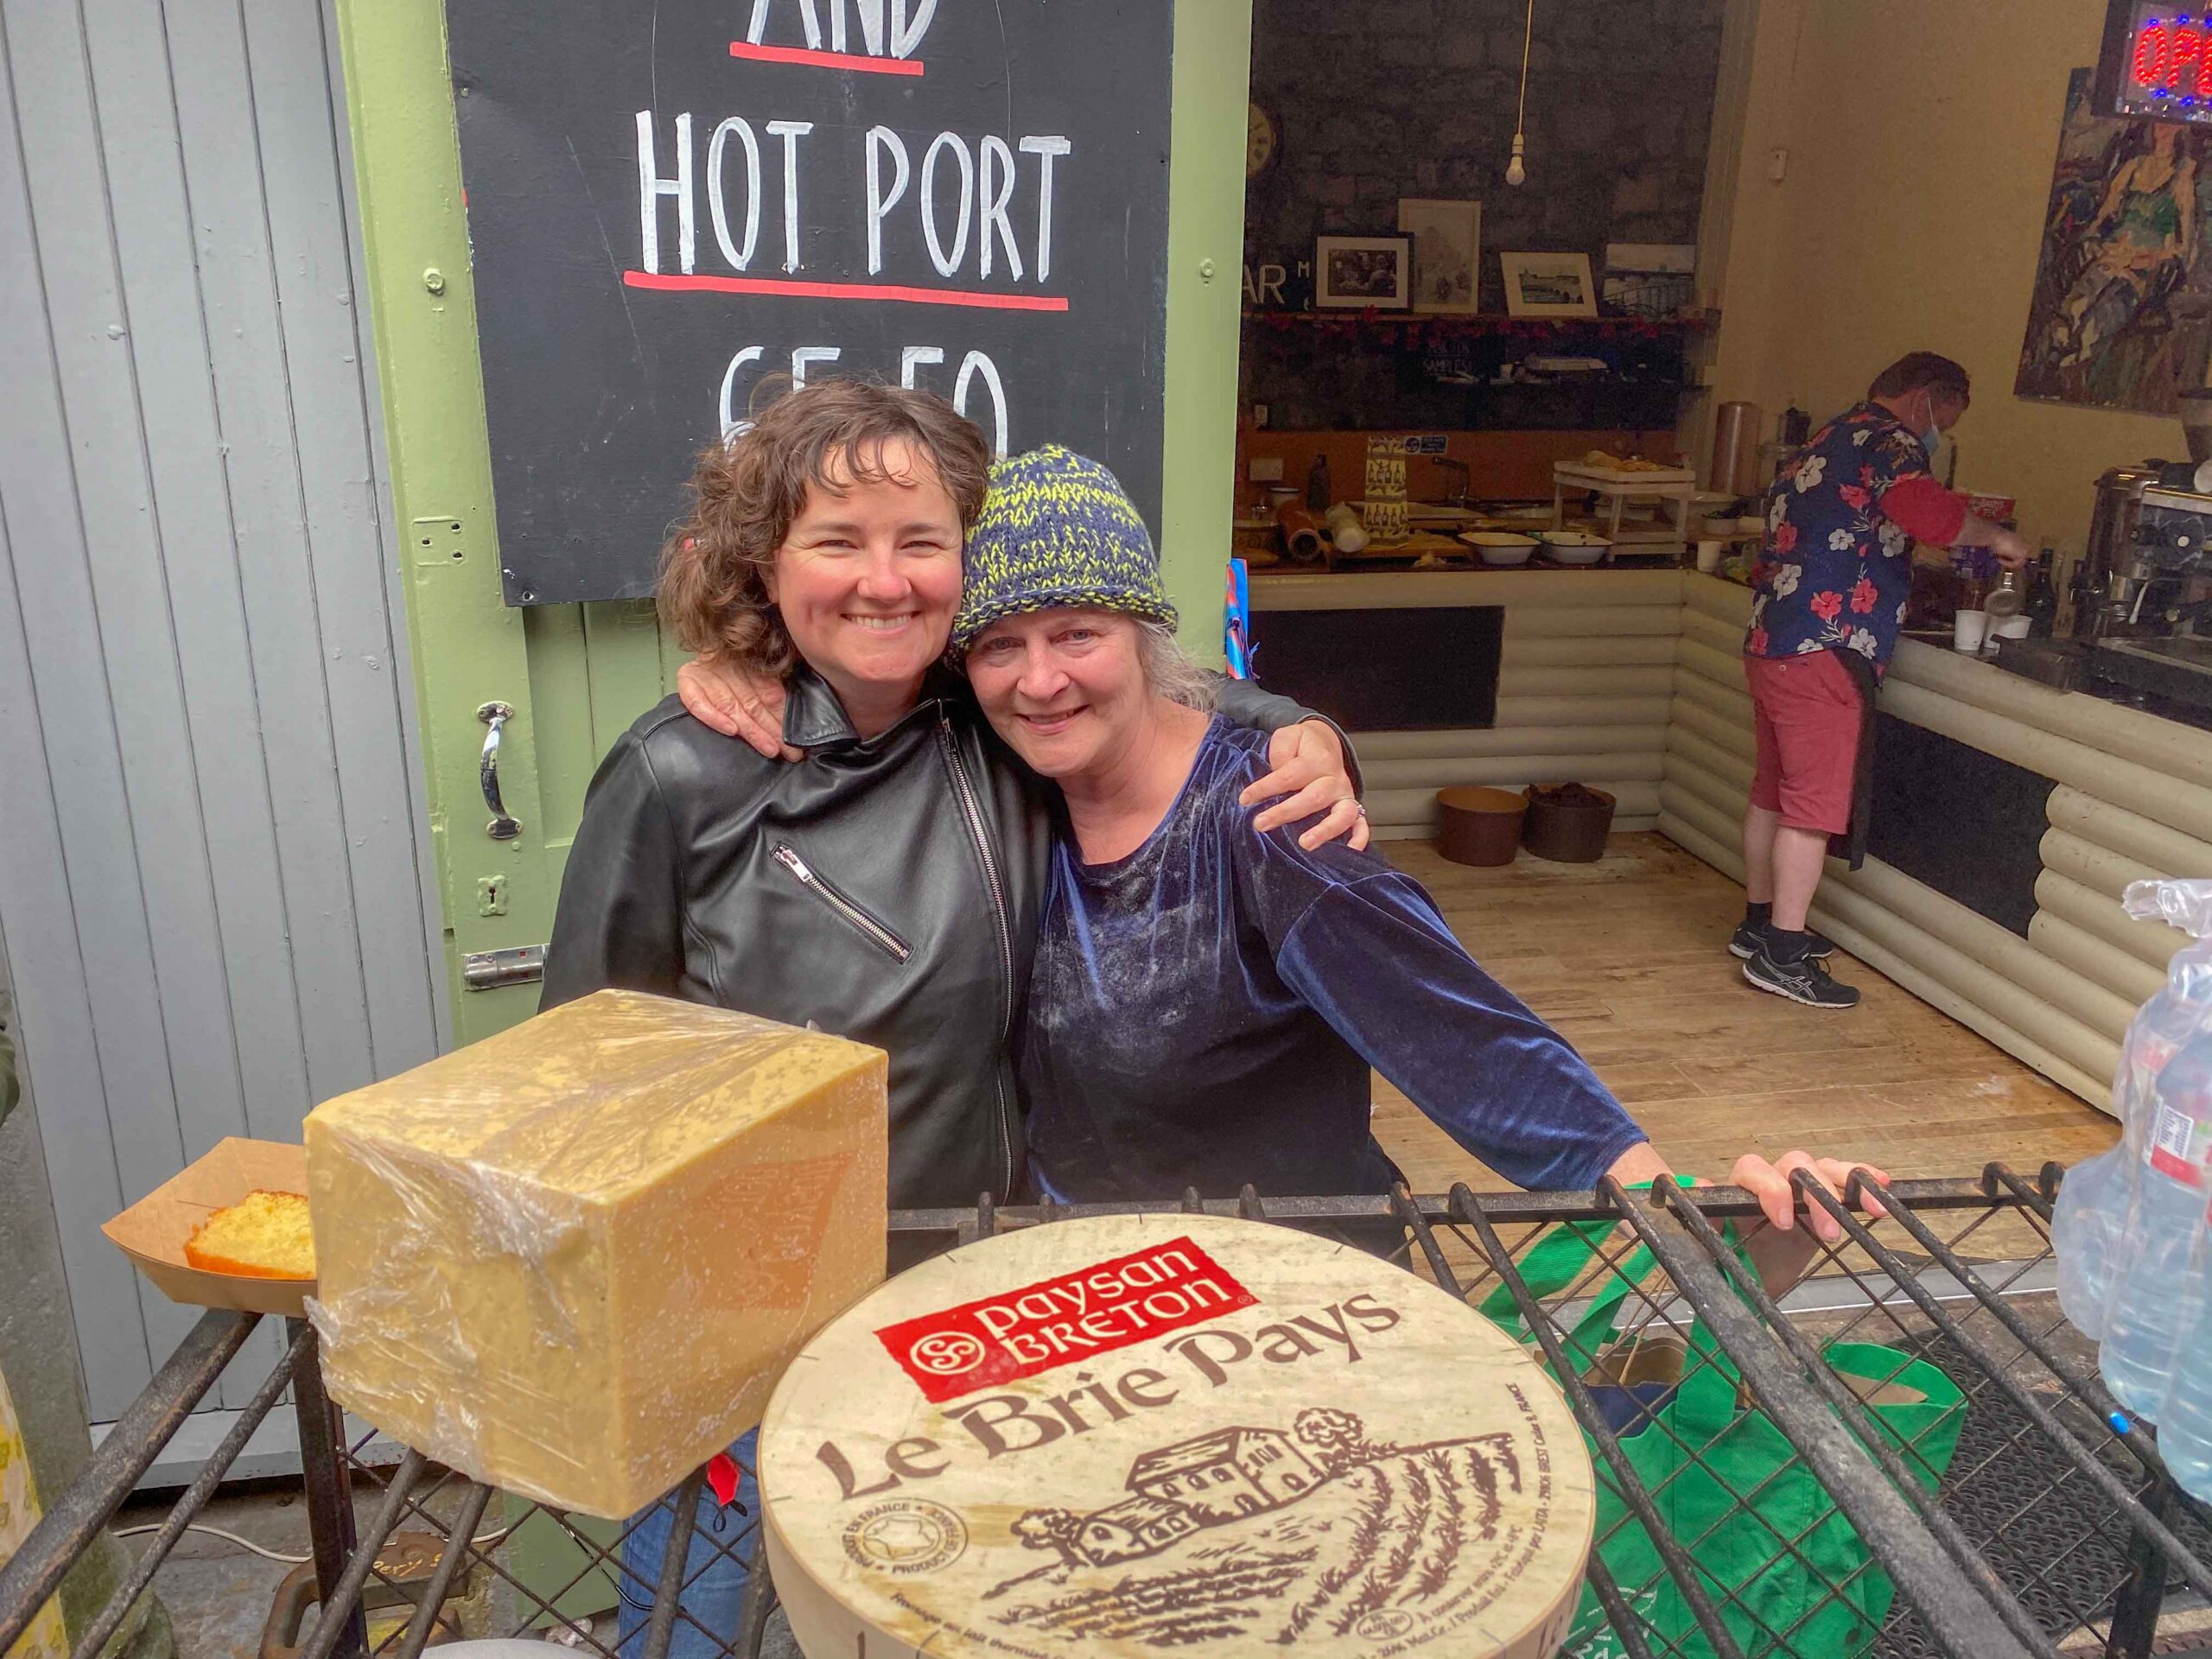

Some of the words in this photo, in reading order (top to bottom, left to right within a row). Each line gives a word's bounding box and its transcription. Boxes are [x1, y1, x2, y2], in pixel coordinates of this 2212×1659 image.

[635, 110, 814, 274] HOT
[865, 124, 1071, 283] PORT
[815, 1435, 950, 1499] Le
[941, 1368, 1179, 1459] Brie
[1164, 1293, 1401, 1389] Pays
[1505, 1382, 1534, 1413] FRANCE
[859, 1503, 911, 1523] FRANCE
